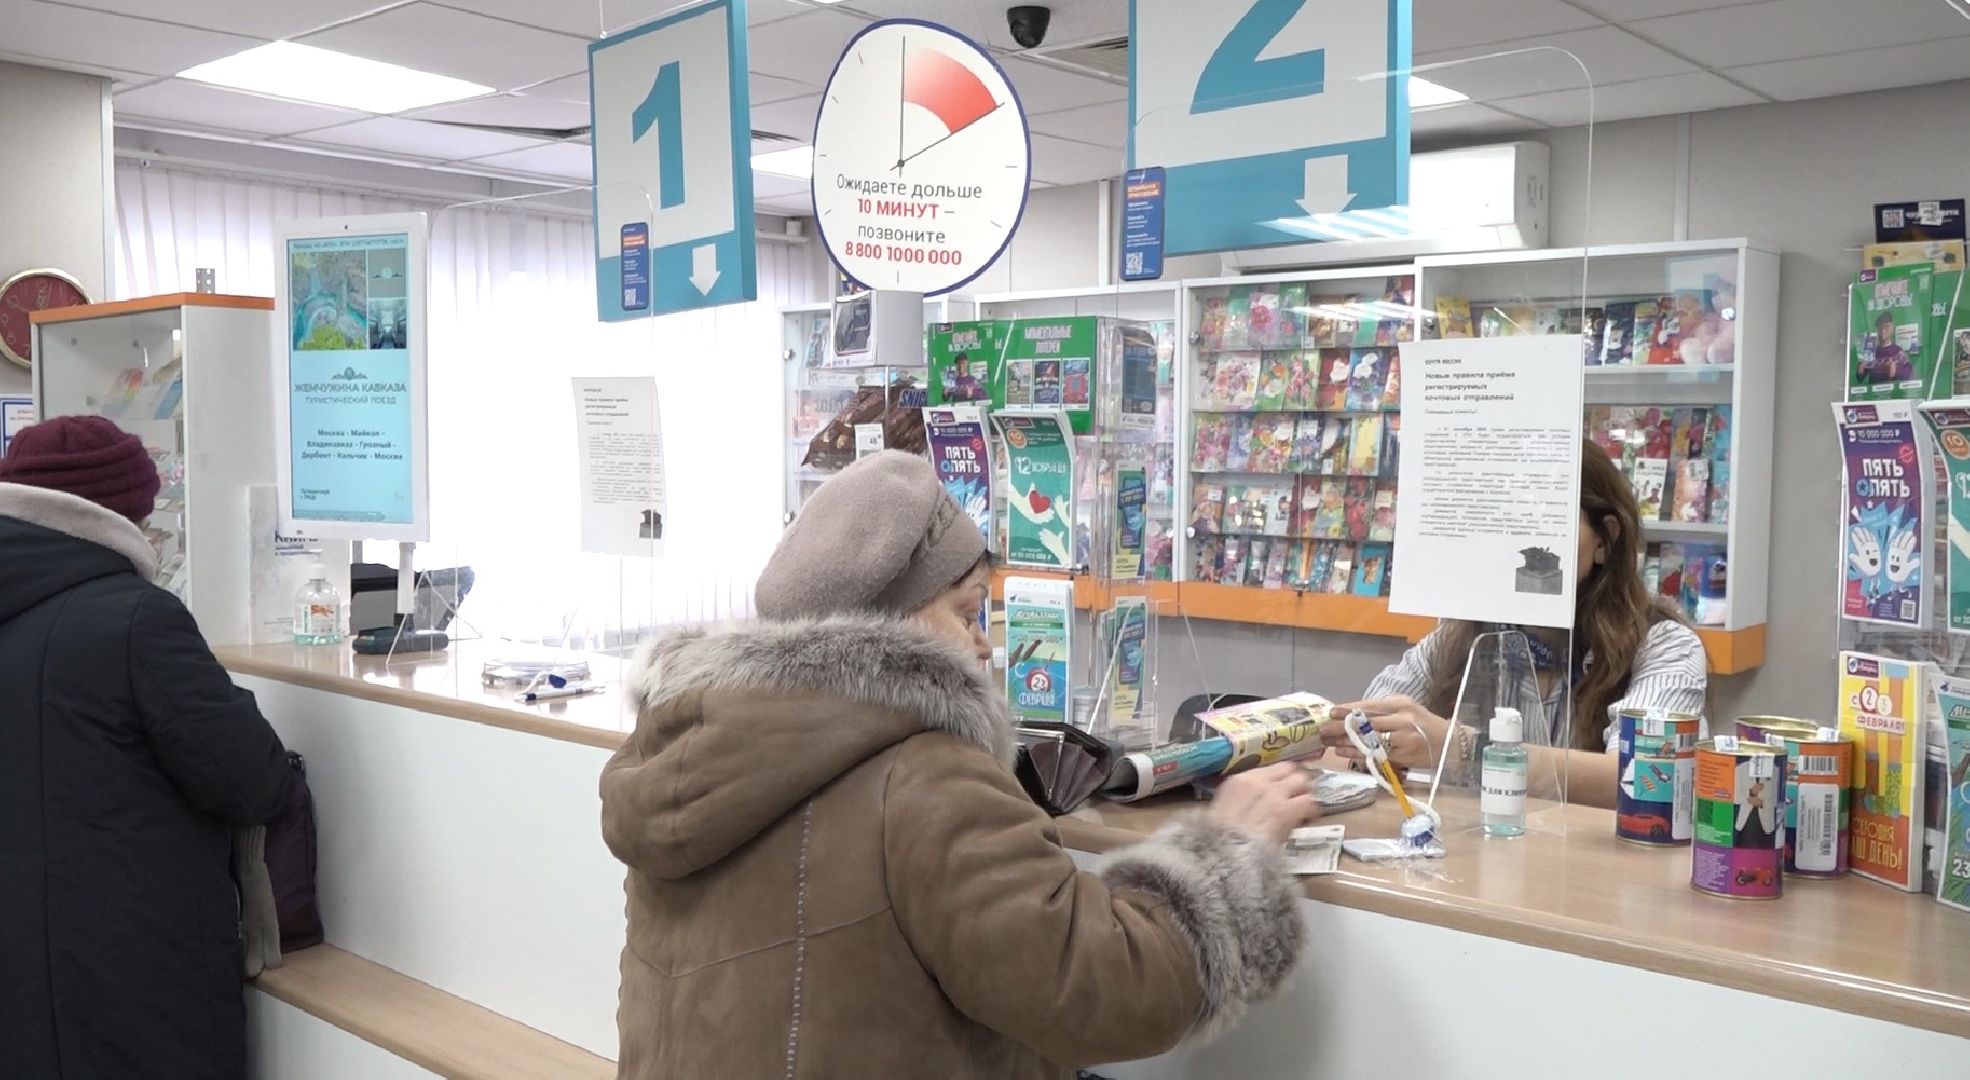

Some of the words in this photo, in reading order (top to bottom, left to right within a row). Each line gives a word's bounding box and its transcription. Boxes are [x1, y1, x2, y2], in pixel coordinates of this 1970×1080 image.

[1188, 0, 1325, 116] 2
[632, 60, 686, 210] 1
[836, 173, 907, 196] Ожидаете
[911, 183, 982, 199] дольше
[857, 198, 872, 214] 10
[876, 200, 940, 220] МИНУТ
[858, 225, 946, 244] позвоните
[845, 241, 854, 256] 8
[855, 242, 882, 260] 800
[928, 249, 962, 266] 000
[294, 383, 360, 393] ЖЕМЧУЖИНА
[362, 383, 407, 393] КАВКАЗА
[305, 396, 369, 405] ТУРИСТИЧЕСКИЙ
[370, 396, 397, 405] ПОЕЗД
[945, 446, 976, 460] ПЯТЬ
[940, 459, 981, 473] ОПЯТЬ
[1862, 458, 1905, 477] ПЯТЬ
[1856, 479, 1911, 498] ОПЯТЬ
